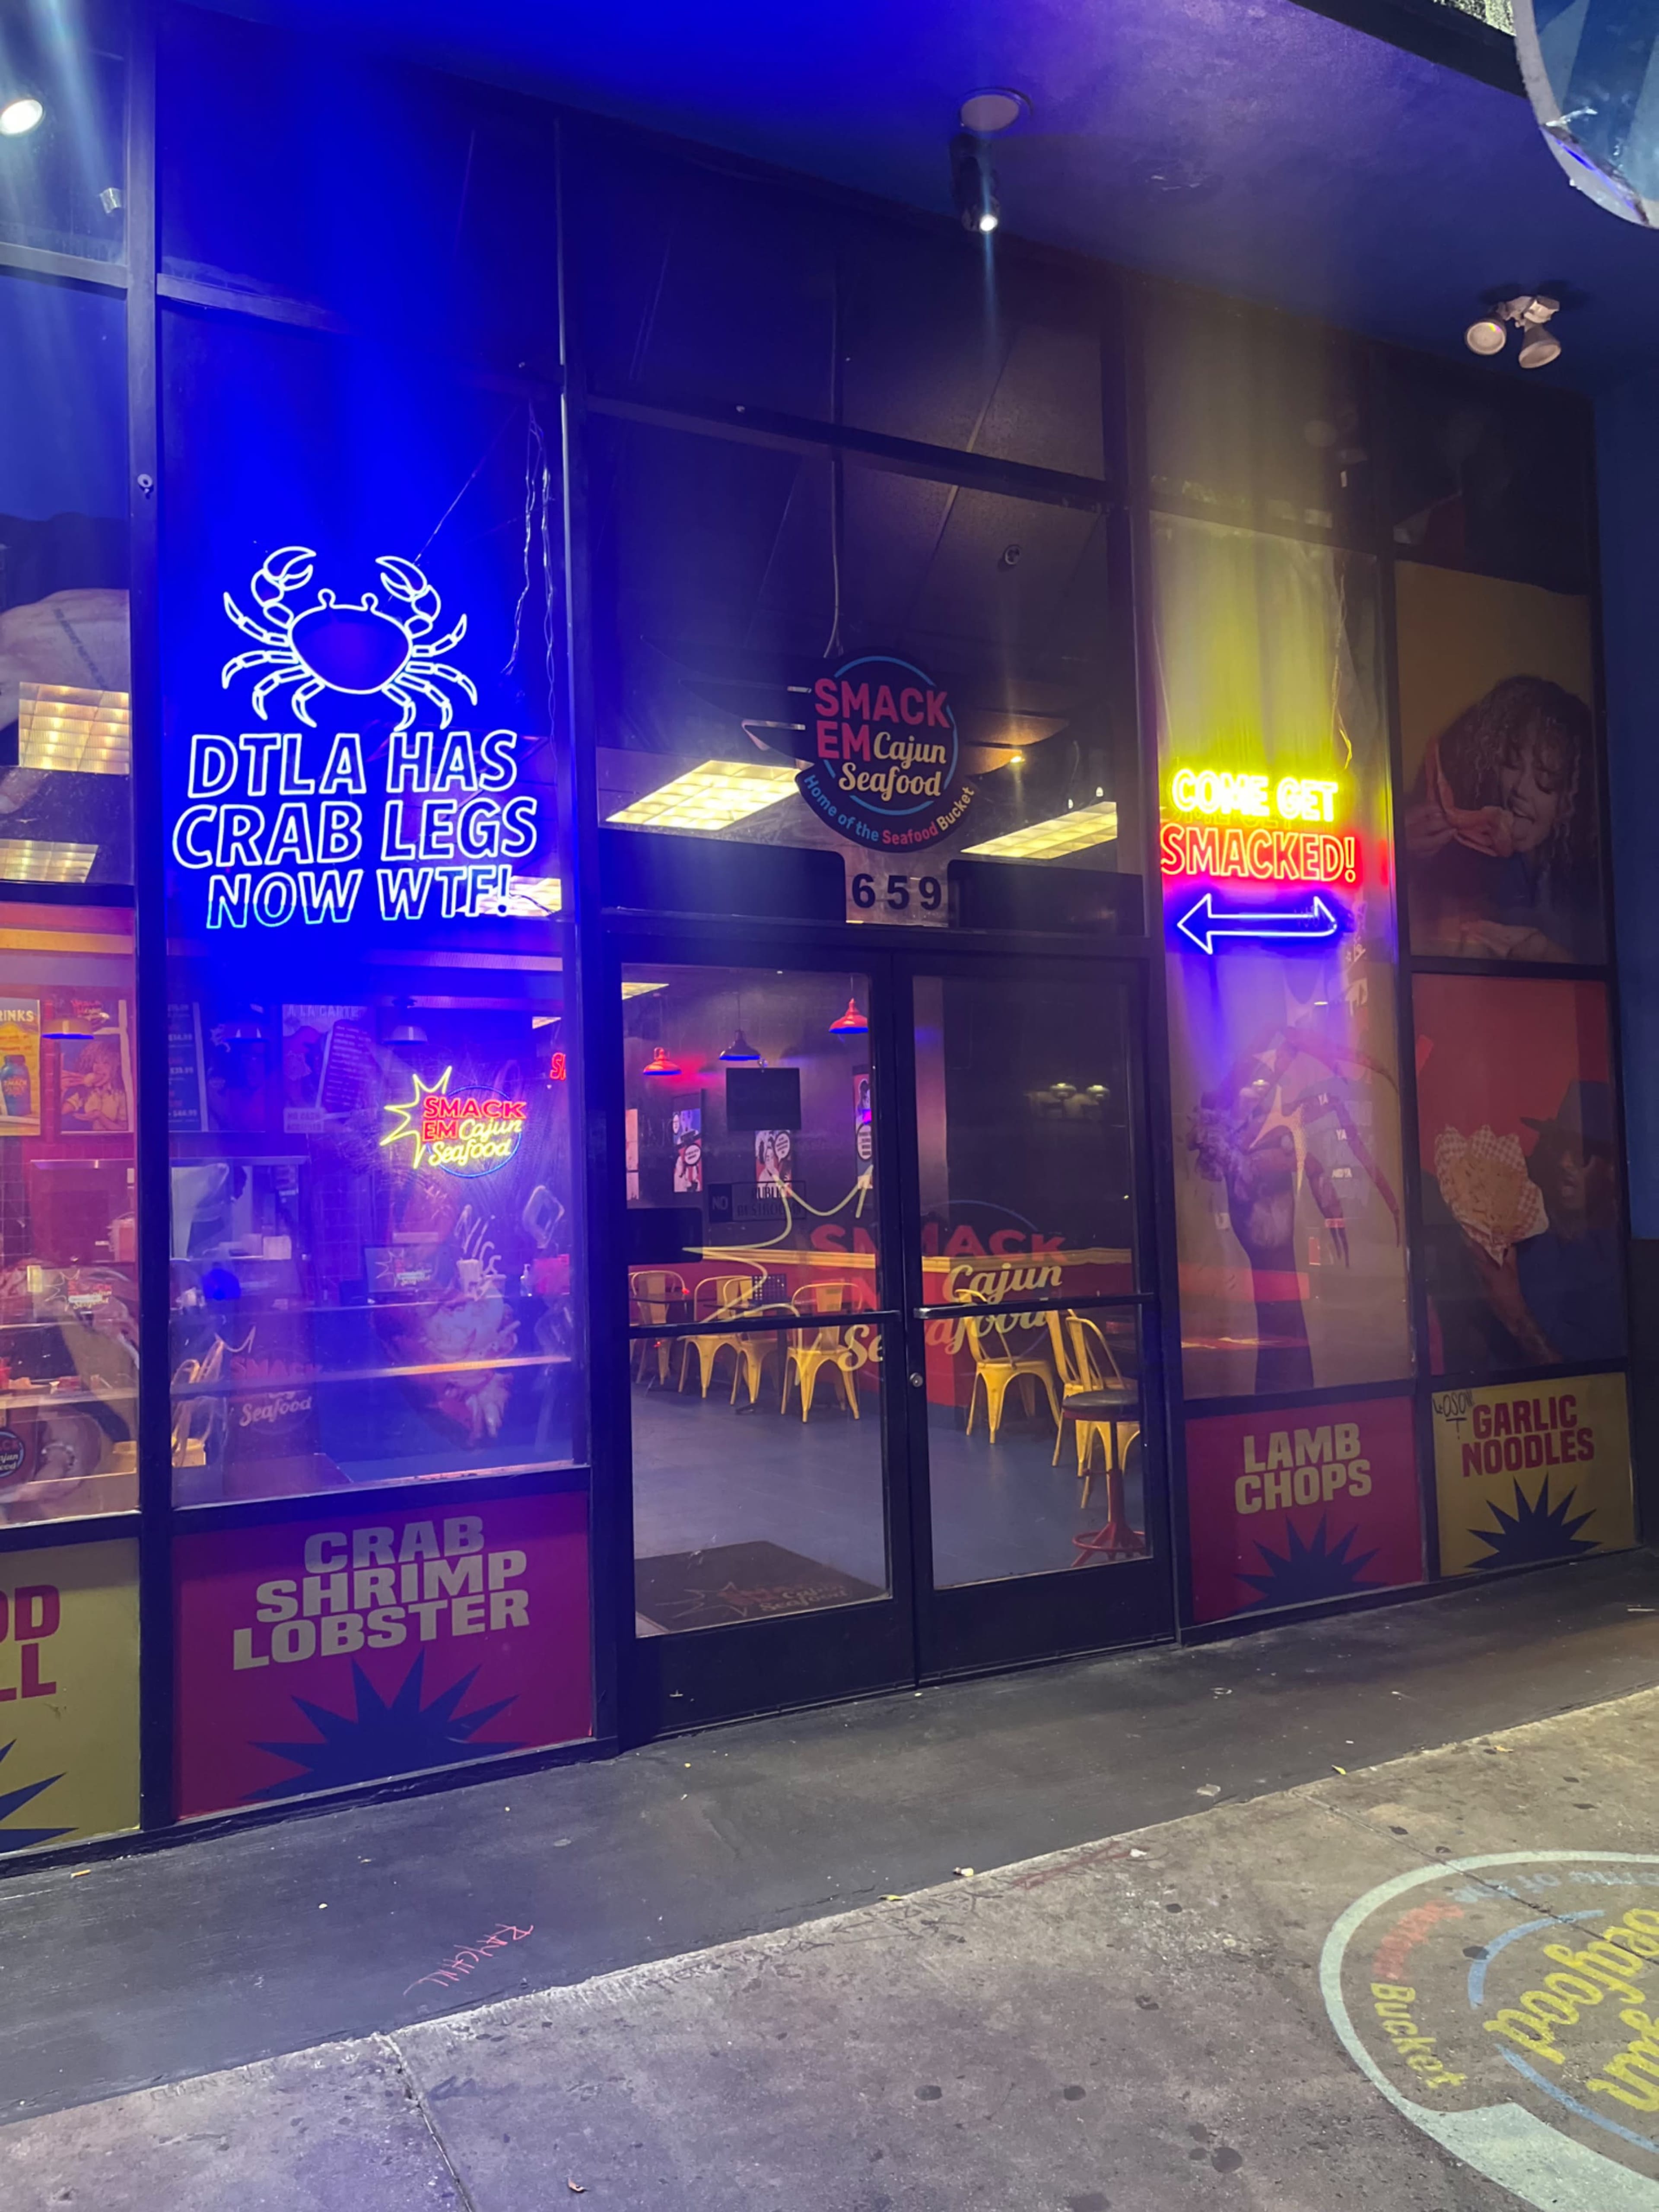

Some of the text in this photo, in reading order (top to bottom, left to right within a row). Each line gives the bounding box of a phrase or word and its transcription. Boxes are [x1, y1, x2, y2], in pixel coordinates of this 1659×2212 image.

[815, 678, 950, 728] SMACK
[188, 729, 518, 798] DTLA HAS
[817, 720, 946, 768] EM Cajun
[839, 762, 941, 801] Seafood
[1171, 768, 1338, 822] COME GET
[173, 796, 537, 869] CRAB LEGS
[804, 775, 975, 845] Home of the Seafood Bucket
[1160, 823, 1356, 883] SMACKED!
[206, 864, 512, 928] NOW WTF!
[852, 873, 942, 910] 659
[422, 1117, 522, 1143] EM Cajun
[423, 1096, 527, 1120] SMACK
[429, 1138, 512, 1166] Seafood
[712, 1196, 728, 1210] NO
[942, 1262, 1063, 1305] Cajun
[239, 1396, 312, 1427] Seafood
[1472, 1394, 1577, 1440] GARLIC
[1242, 1422, 1361, 1474] LAMB
[1462, 1427, 1595, 1478] NOODLES
[1234, 1459, 1373, 1515] CHOPS
[304, 1515, 485, 1574] CRAB
[0, 1584, 60, 1641] D
[255, 1549, 527, 1624] SHRIMP
[233, 1589, 530, 1671] LOBSTER
[1371, 1982, 1467, 2089] Bucket
